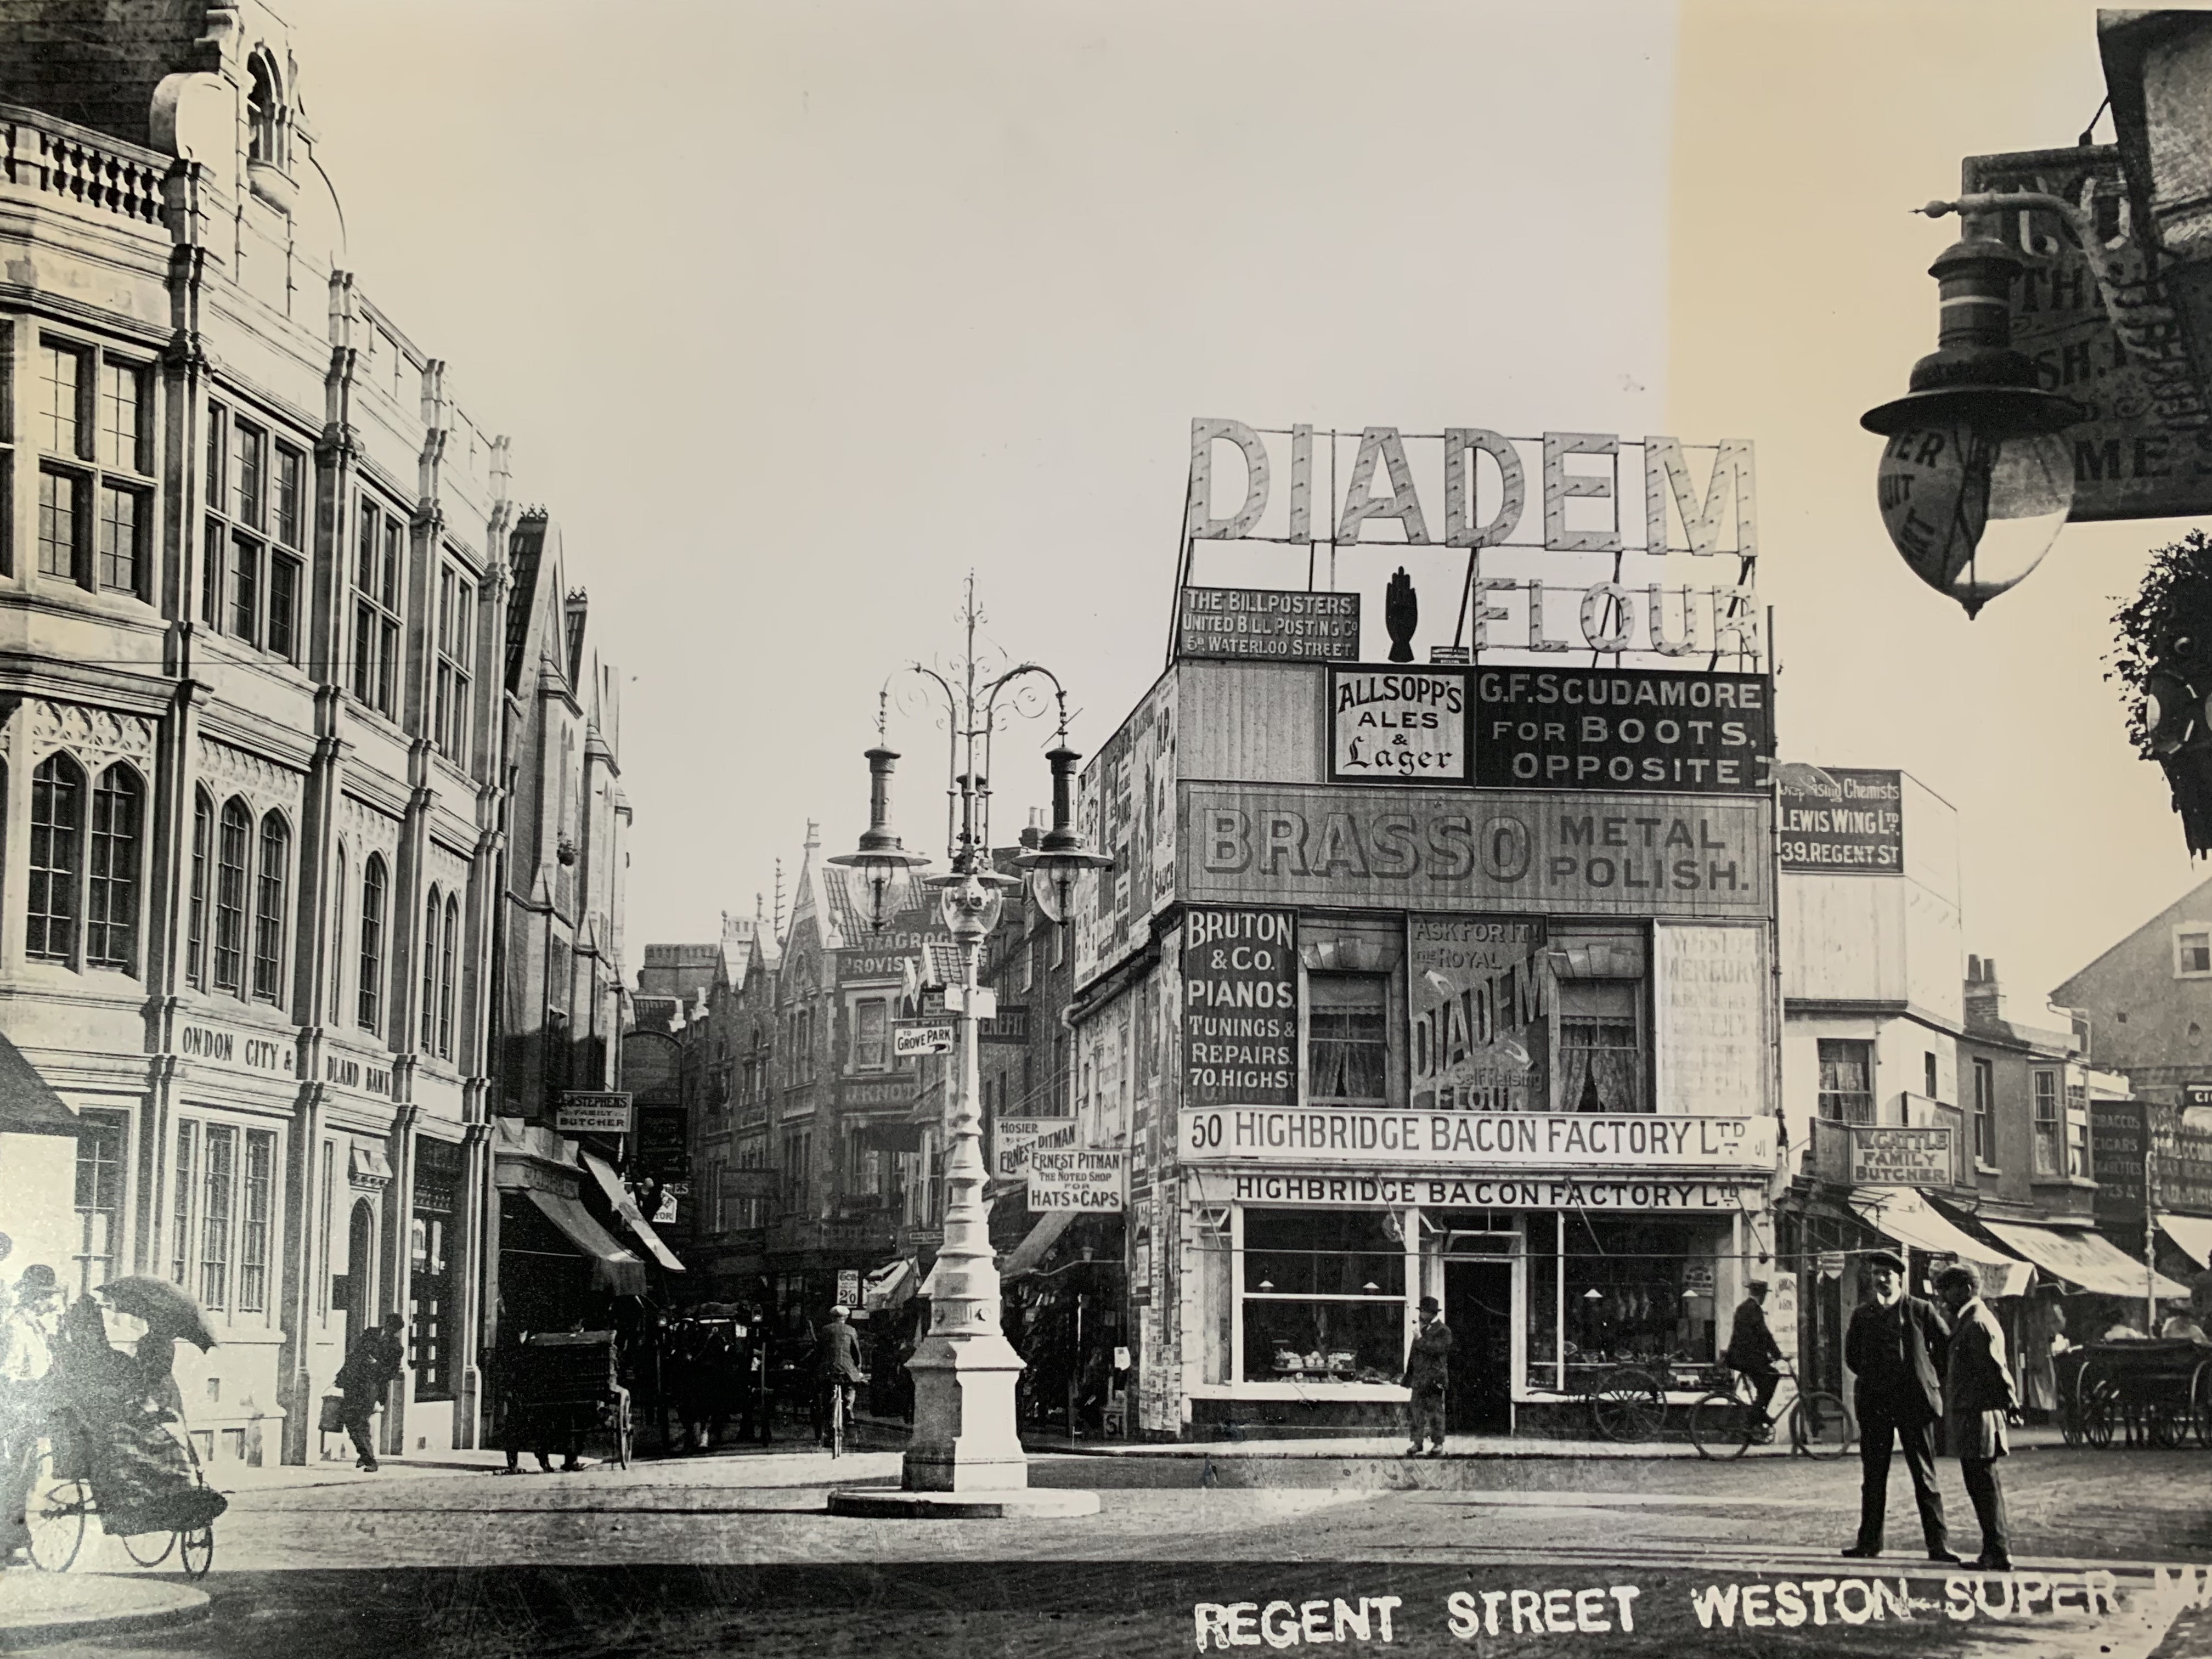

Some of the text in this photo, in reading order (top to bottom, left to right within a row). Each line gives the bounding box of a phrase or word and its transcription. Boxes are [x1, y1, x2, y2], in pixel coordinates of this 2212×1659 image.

[1192, 417, 1757, 556] DIADEM
[1187, 589, 1223, 612] THE
[1183, 613, 1234, 632] UNITED
[1276, 618, 1340, 637] POSTING
[1473, 577, 1762, 657] FLOUR
[1209, 636, 1287, 654] WATERLOO
[1338, 676, 1464, 715] ALLSOPP'S
[1357, 712, 1440, 729] ALES
[1492, 721, 1565, 742] FOR
[1392, 733, 1408, 746] &
[1342, 736, 1453, 775] Lager
[1513, 752, 1740, 785] OPPOSITE
[1844, 777, 1899, 800] Chemists
[1780, 809, 1830, 833] LEWIS
[1831, 808, 1876, 834] WING
[1204, 806, 1532, 882] BRASSO
[1559, 816, 1727, 850] METAL
[1188, 911, 1293, 950] BRUTON
[1415, 922, 1459, 942] ASK
[1461, 921, 1505, 943] FOR
[1211, 949, 1227, 970] &
[1438, 948, 1503, 969] ROYAL
[1411, 946, 1549, 1080] DIADEM
[1189, 1015, 1295, 1038] TUNINGS &
[898, 1029, 951, 1051] GROVE PARK
[183, 1025, 390, 1096] ONDON CITY & DLAND BANK
[576, 1097, 628, 1108] STEPHENS
[1434, 1085, 1528, 1111] FLOUR
[560, 1118, 625, 1126] BUTCHER
[1001, 1122, 1039, 1133] HOSIER
[1191, 1114, 1222, 1148] 50
[1235, 1111, 1420, 1151] HIGHBRIDGE
[1431, 1116, 1537, 1153] BACON
[1548, 1119, 1691, 1154] FACTORY
[1032, 1152, 1120, 1171] ERNEST PITMAN
[1864, 1152, 1938, 1167] FAMILY
[1040, 1172, 1113, 1182] THE NOTED SHOP
[1855, 1166, 1946, 1182] BUTCHER
[1031, 1190, 1119, 1207] HATS & CAPS
[1236, 1177, 1416, 1203] HIGHBRIDGE
[1429, 1181, 1539, 1205] BACON
[1550, 1182, 1696, 1207] FACTORY
